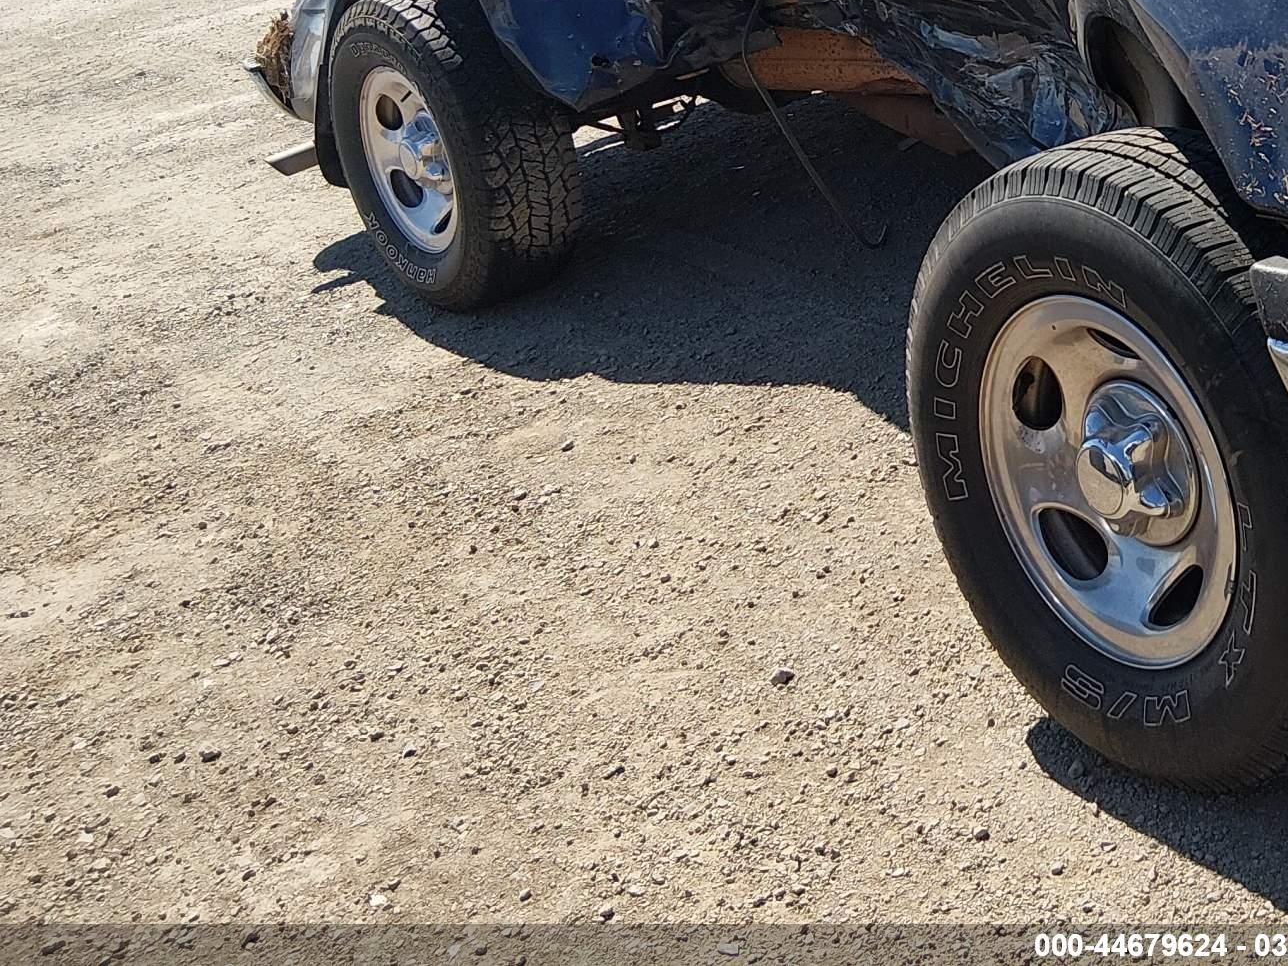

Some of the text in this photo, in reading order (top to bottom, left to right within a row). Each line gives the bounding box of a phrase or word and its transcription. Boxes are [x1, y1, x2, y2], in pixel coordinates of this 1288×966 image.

[933, 254, 1127, 502] MICHELIN
[1061, 501, 1257, 727] LTX M/S
